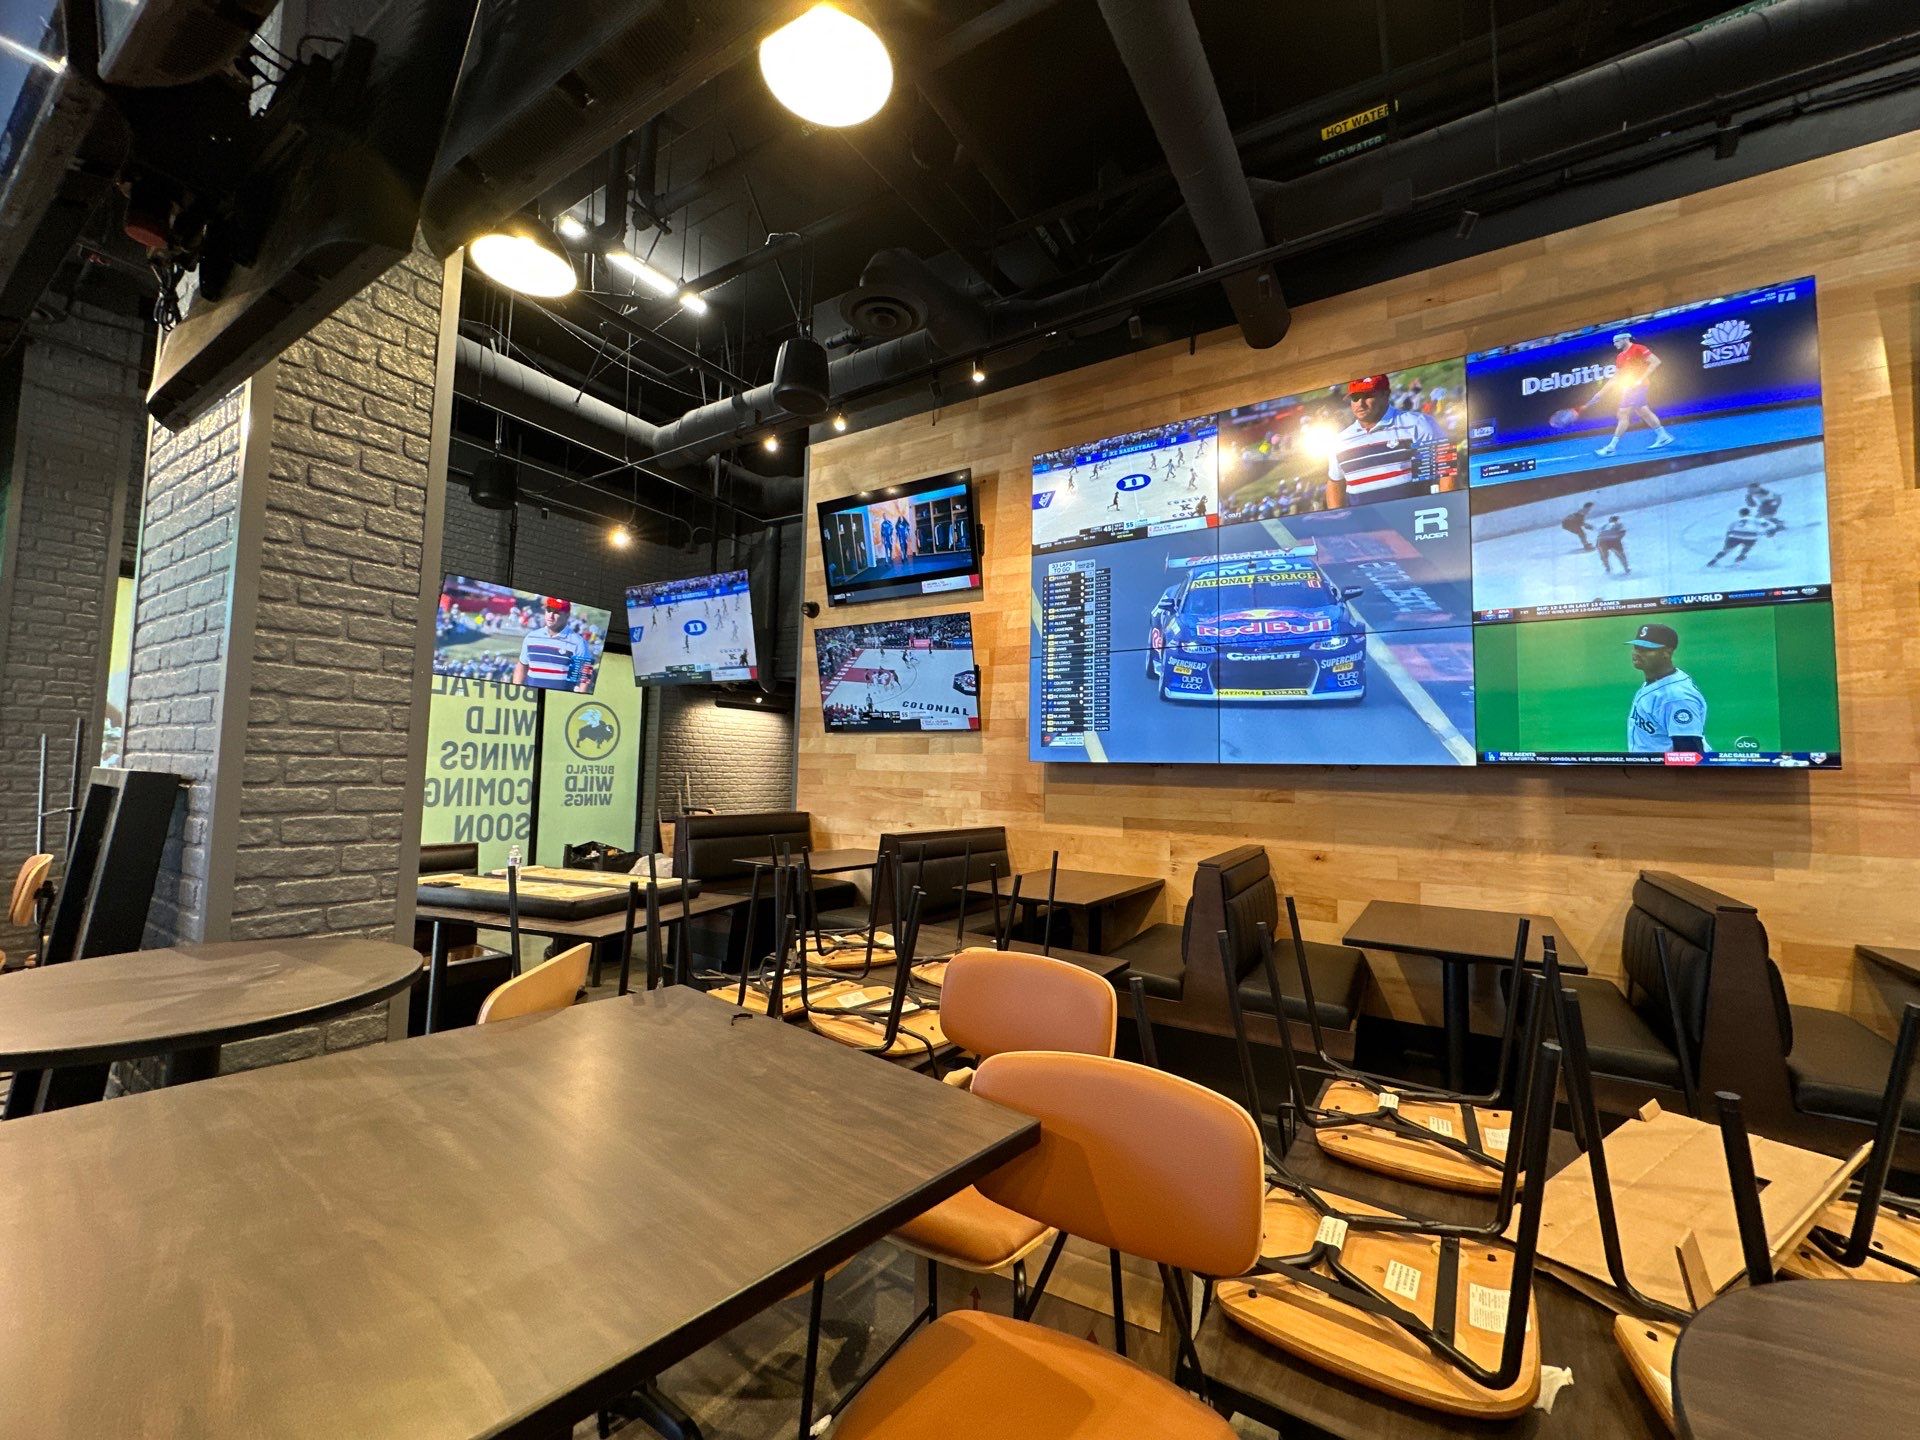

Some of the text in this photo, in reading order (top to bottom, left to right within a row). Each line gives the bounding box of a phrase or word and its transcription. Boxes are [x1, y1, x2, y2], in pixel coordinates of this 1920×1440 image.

[1326, 121, 1349, 138] HOT
[1347, 136, 1381, 154] WATER
[1703, 341, 1750, 364] NSW
[1522, 363, 1617, 396] Deloitte
[1415, 507, 1448, 533] R
[1415, 531, 1449, 541] RACER
[1194, 572, 1317, 588] NATIONAL STORAGE
[1197, 619, 1331, 637] Red Bull
[1168, 656, 1207, 671] SUPERCHEAP
[1337, 671, 1360, 680] QUAD
[1337, 679, 1360, 687] LOCK
[902, 700, 970, 716] COLONIAL
